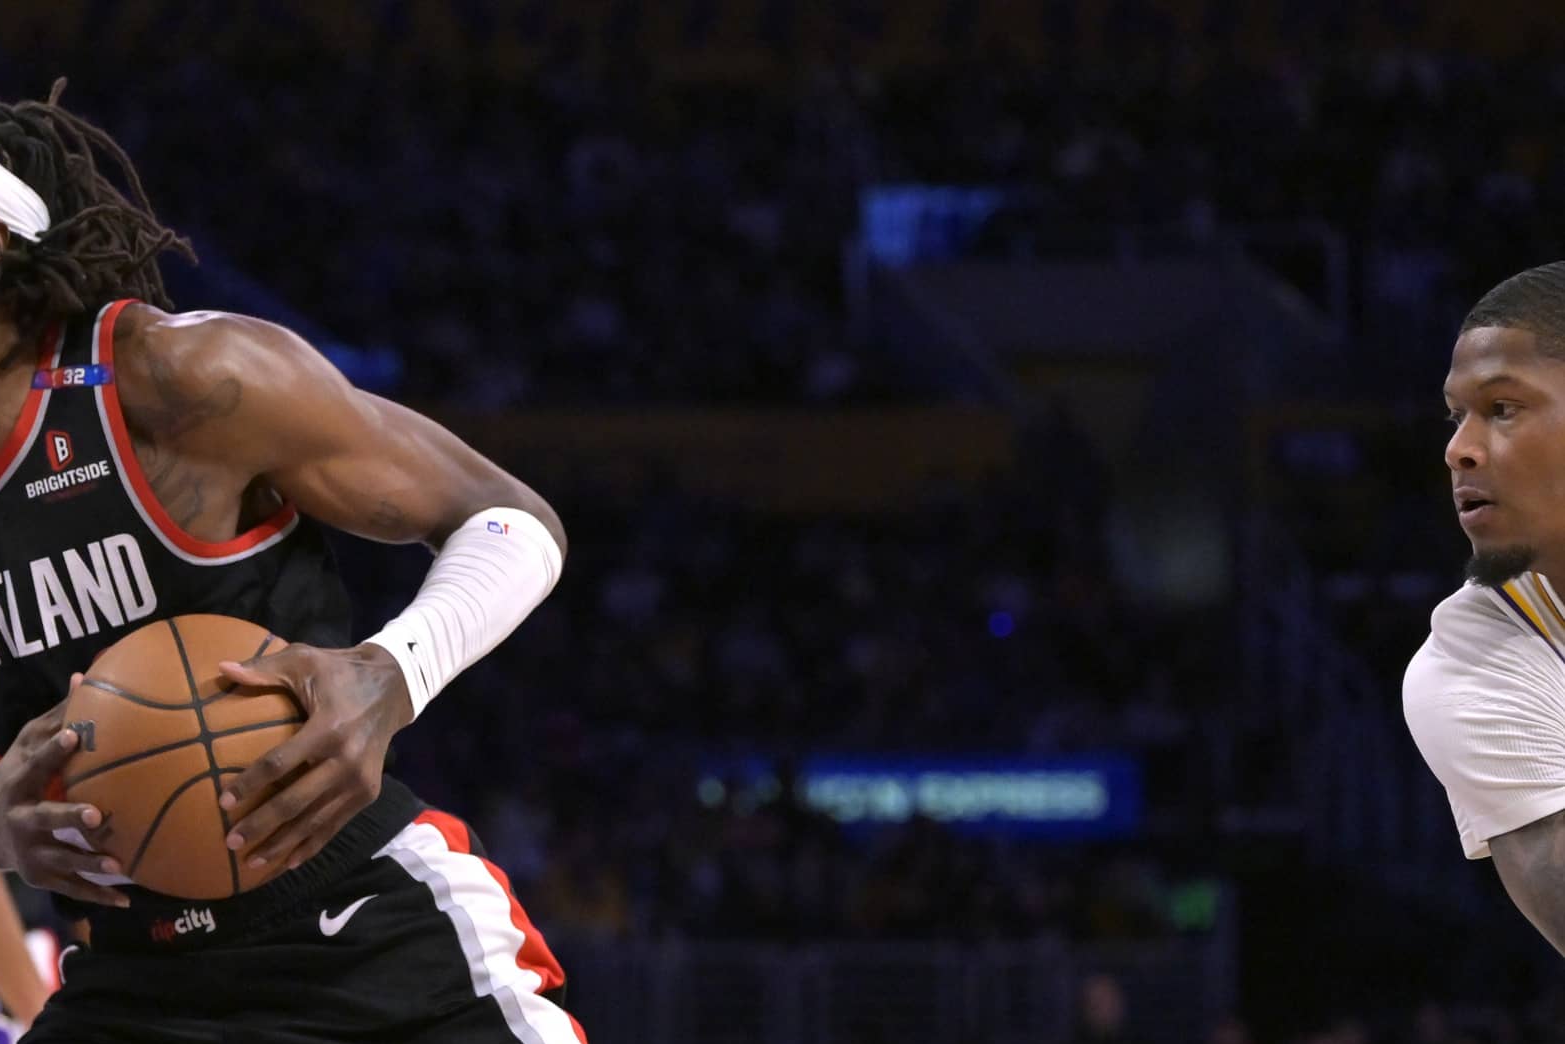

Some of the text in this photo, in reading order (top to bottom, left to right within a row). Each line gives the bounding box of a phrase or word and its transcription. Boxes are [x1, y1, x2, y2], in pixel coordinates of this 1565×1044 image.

[63, 367, 85, 385] 32
[54, 436, 70, 463] B
[25, 460, 111, 499] BRIGHTSIDE
